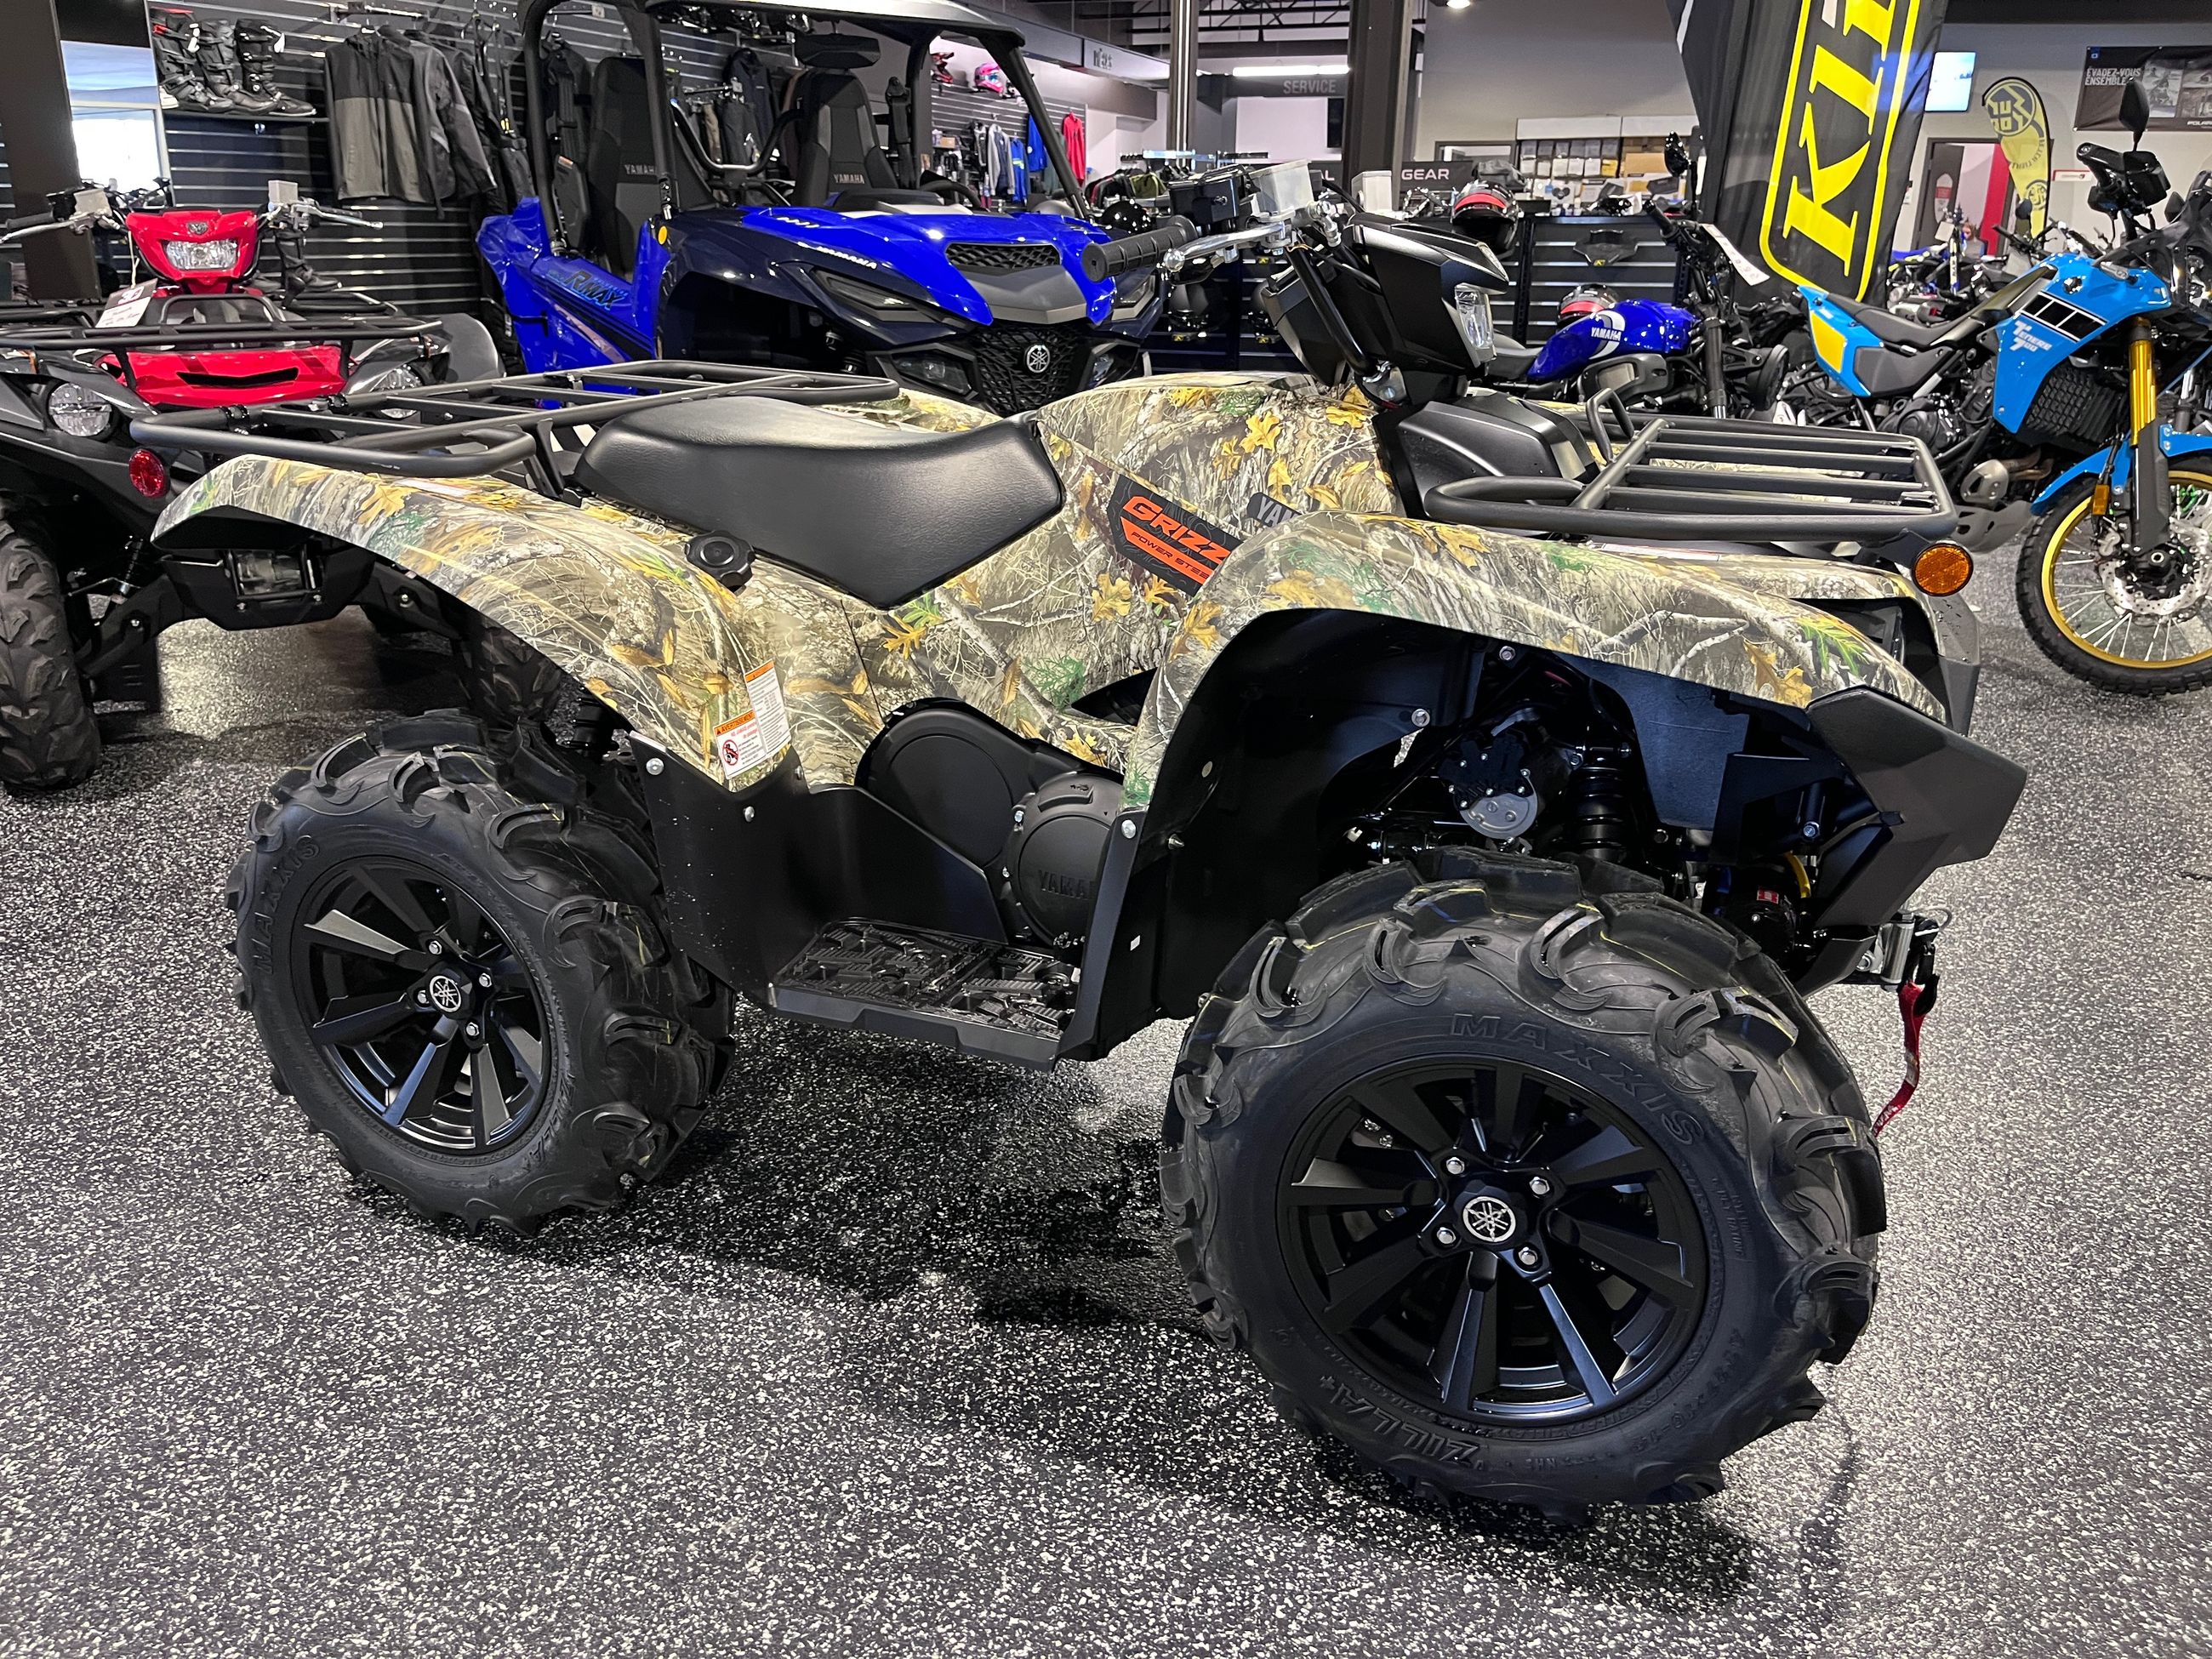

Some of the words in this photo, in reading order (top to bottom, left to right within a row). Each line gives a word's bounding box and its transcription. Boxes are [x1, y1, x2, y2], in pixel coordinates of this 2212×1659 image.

[1283, 79, 1336, 94] SERVICE
[834, 174, 865, 184] YAMAHA
[1401, 168, 1450, 181] GEAR
[1591, 327, 1622, 342] YAMAHA
[1131, 531, 1173, 558] POWER
[251, 835, 320, 975] MAXXIS
[1450, 1012, 1704, 1146] MAXXIS
